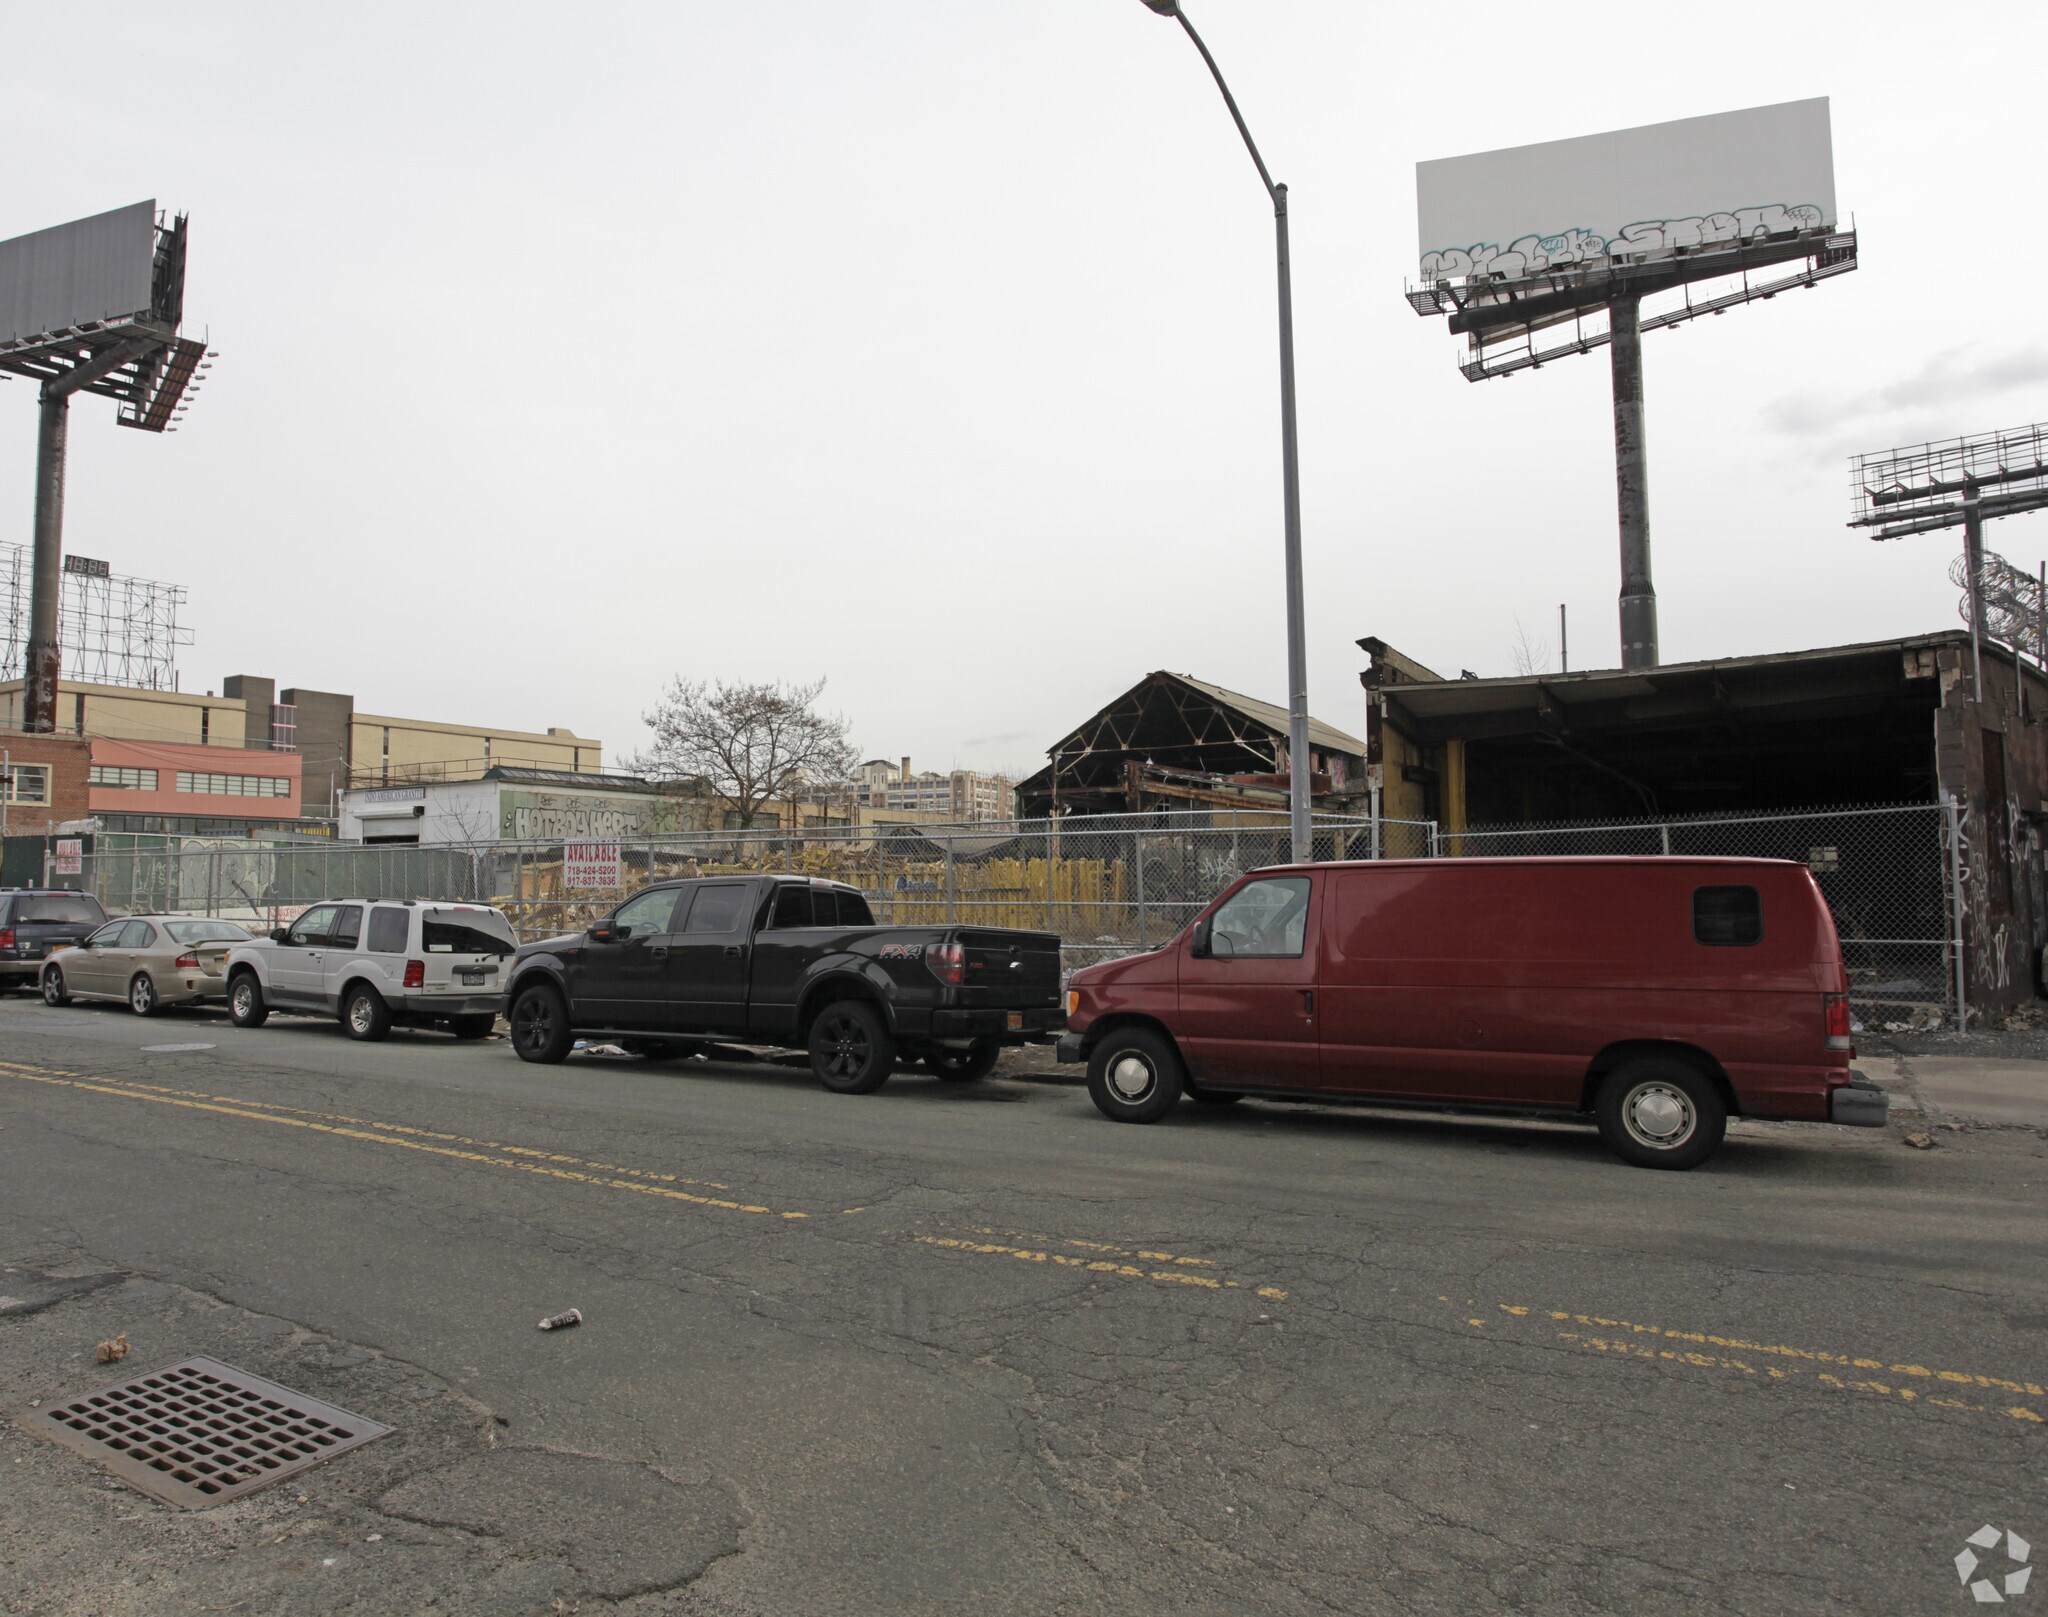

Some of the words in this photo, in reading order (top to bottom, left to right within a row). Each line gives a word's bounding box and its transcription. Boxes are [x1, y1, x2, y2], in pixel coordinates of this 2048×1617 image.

[568, 840, 617, 862] AVAILABLE
[567, 866, 616, 875] 718-424-5200
[880, 944, 923, 956] FX4
